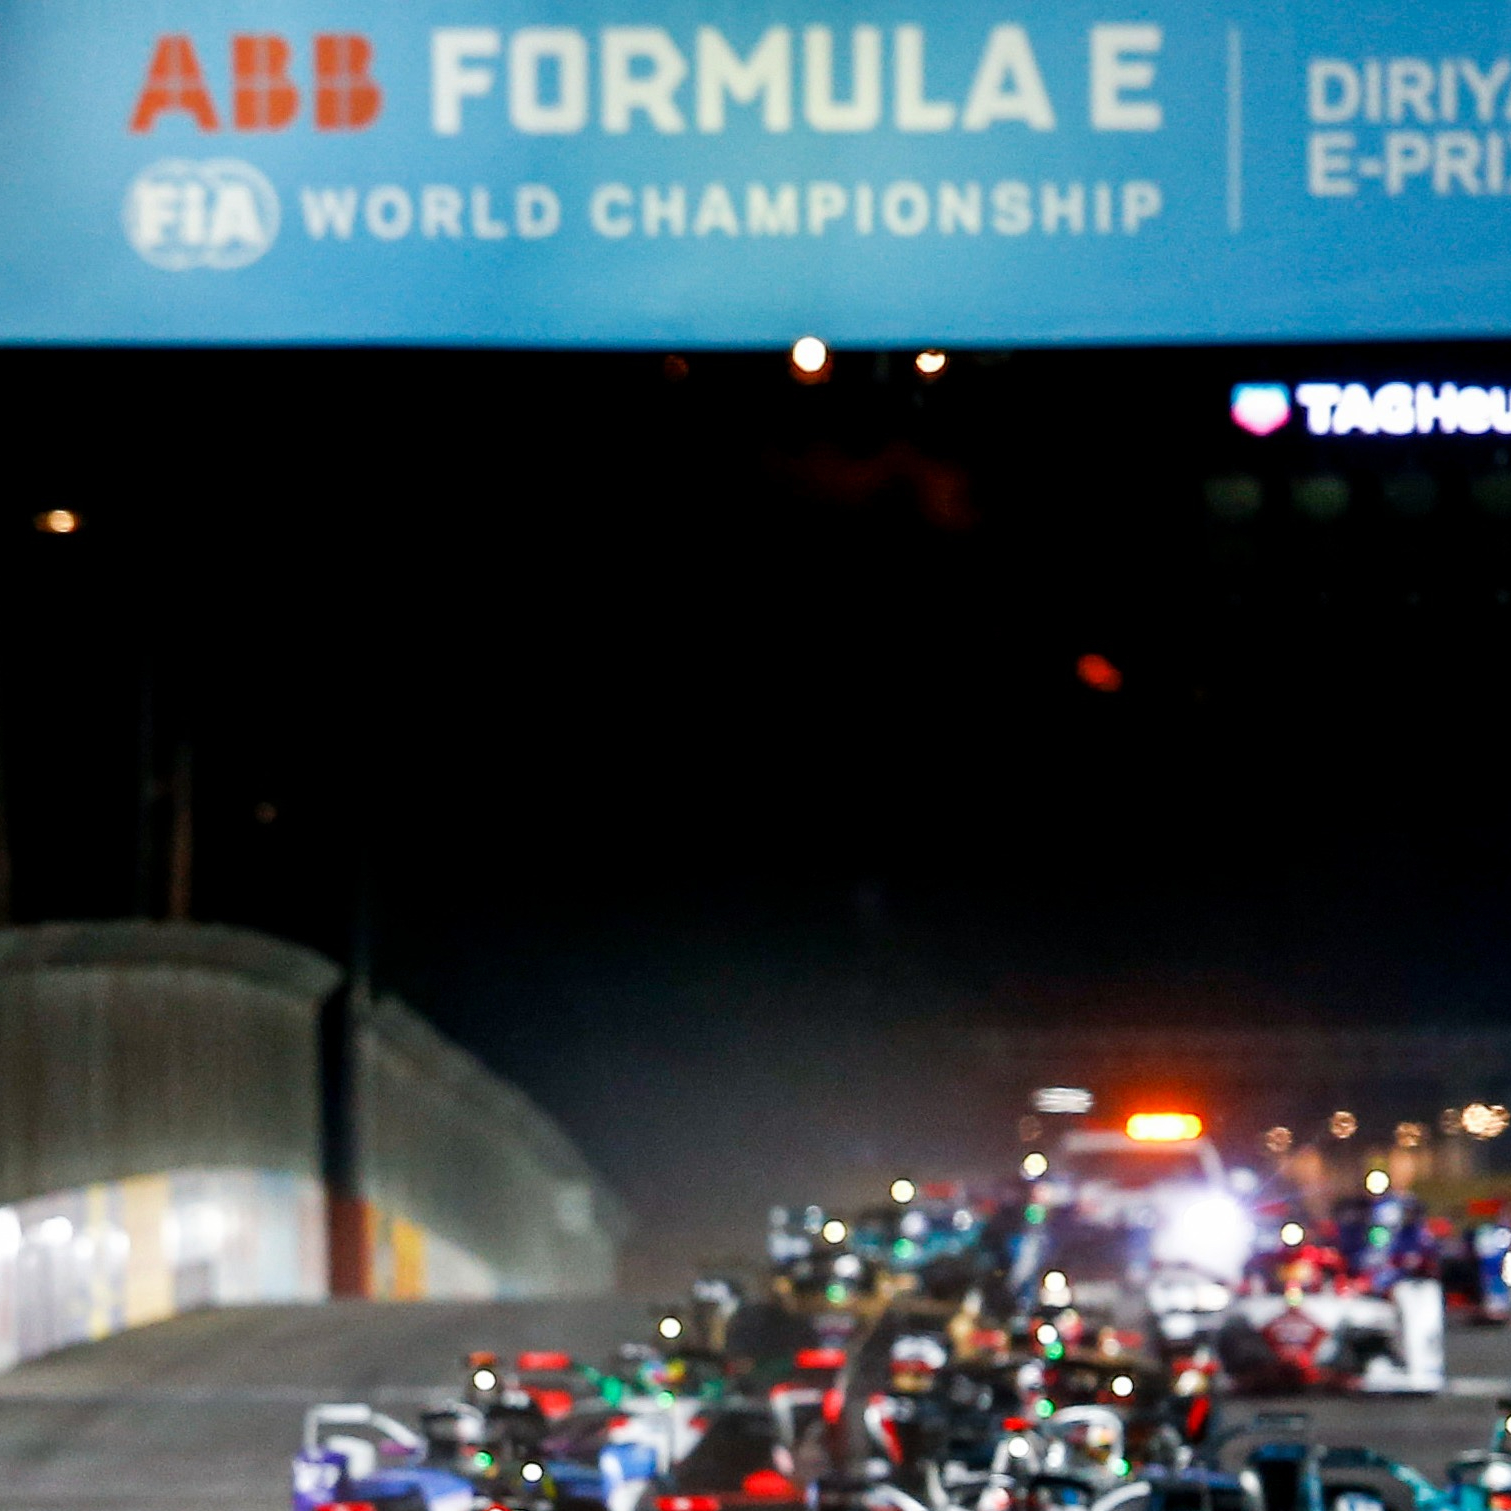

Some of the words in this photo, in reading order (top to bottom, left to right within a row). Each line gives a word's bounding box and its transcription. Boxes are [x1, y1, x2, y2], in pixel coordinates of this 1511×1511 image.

[129, 33, 382, 133] ABB
[432, 25, 1056, 134] FORMULA
[1092, 24, 1163, 131] E
[137, 186, 265, 247] FIA
[302, 186, 561, 240] WORLD
[591, 182, 1163, 238] CHAMPIONSHIP
